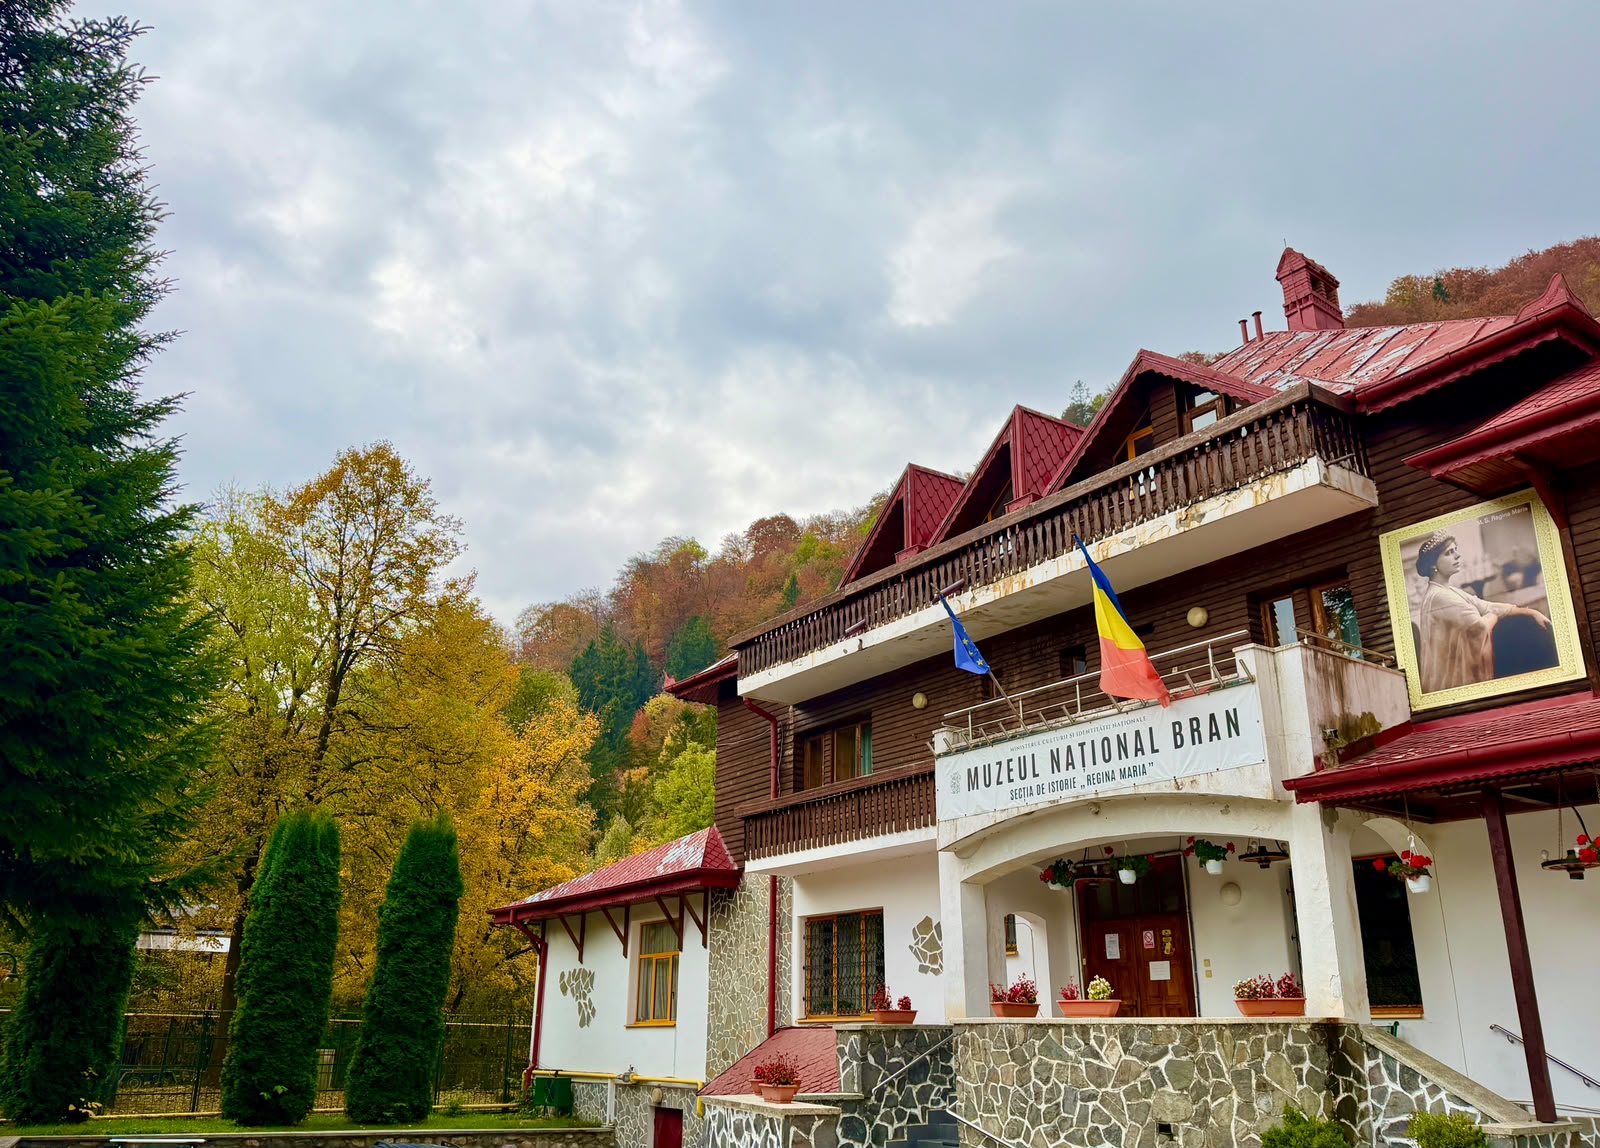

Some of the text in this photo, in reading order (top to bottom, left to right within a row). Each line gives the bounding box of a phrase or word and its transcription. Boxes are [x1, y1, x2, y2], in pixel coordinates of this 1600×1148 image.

[967, 707, 1241, 792] MUZEUL NAȚIONAL BRAN
[1010, 741, 1041, 752] MINISTERUL
[1042, 732, 1068, 745] CULTURII
[1010, 785, 1034, 802] SECȚIA
[1036, 783, 1045, 796] DE
[1048, 776, 1077, 793] ISTORIE
